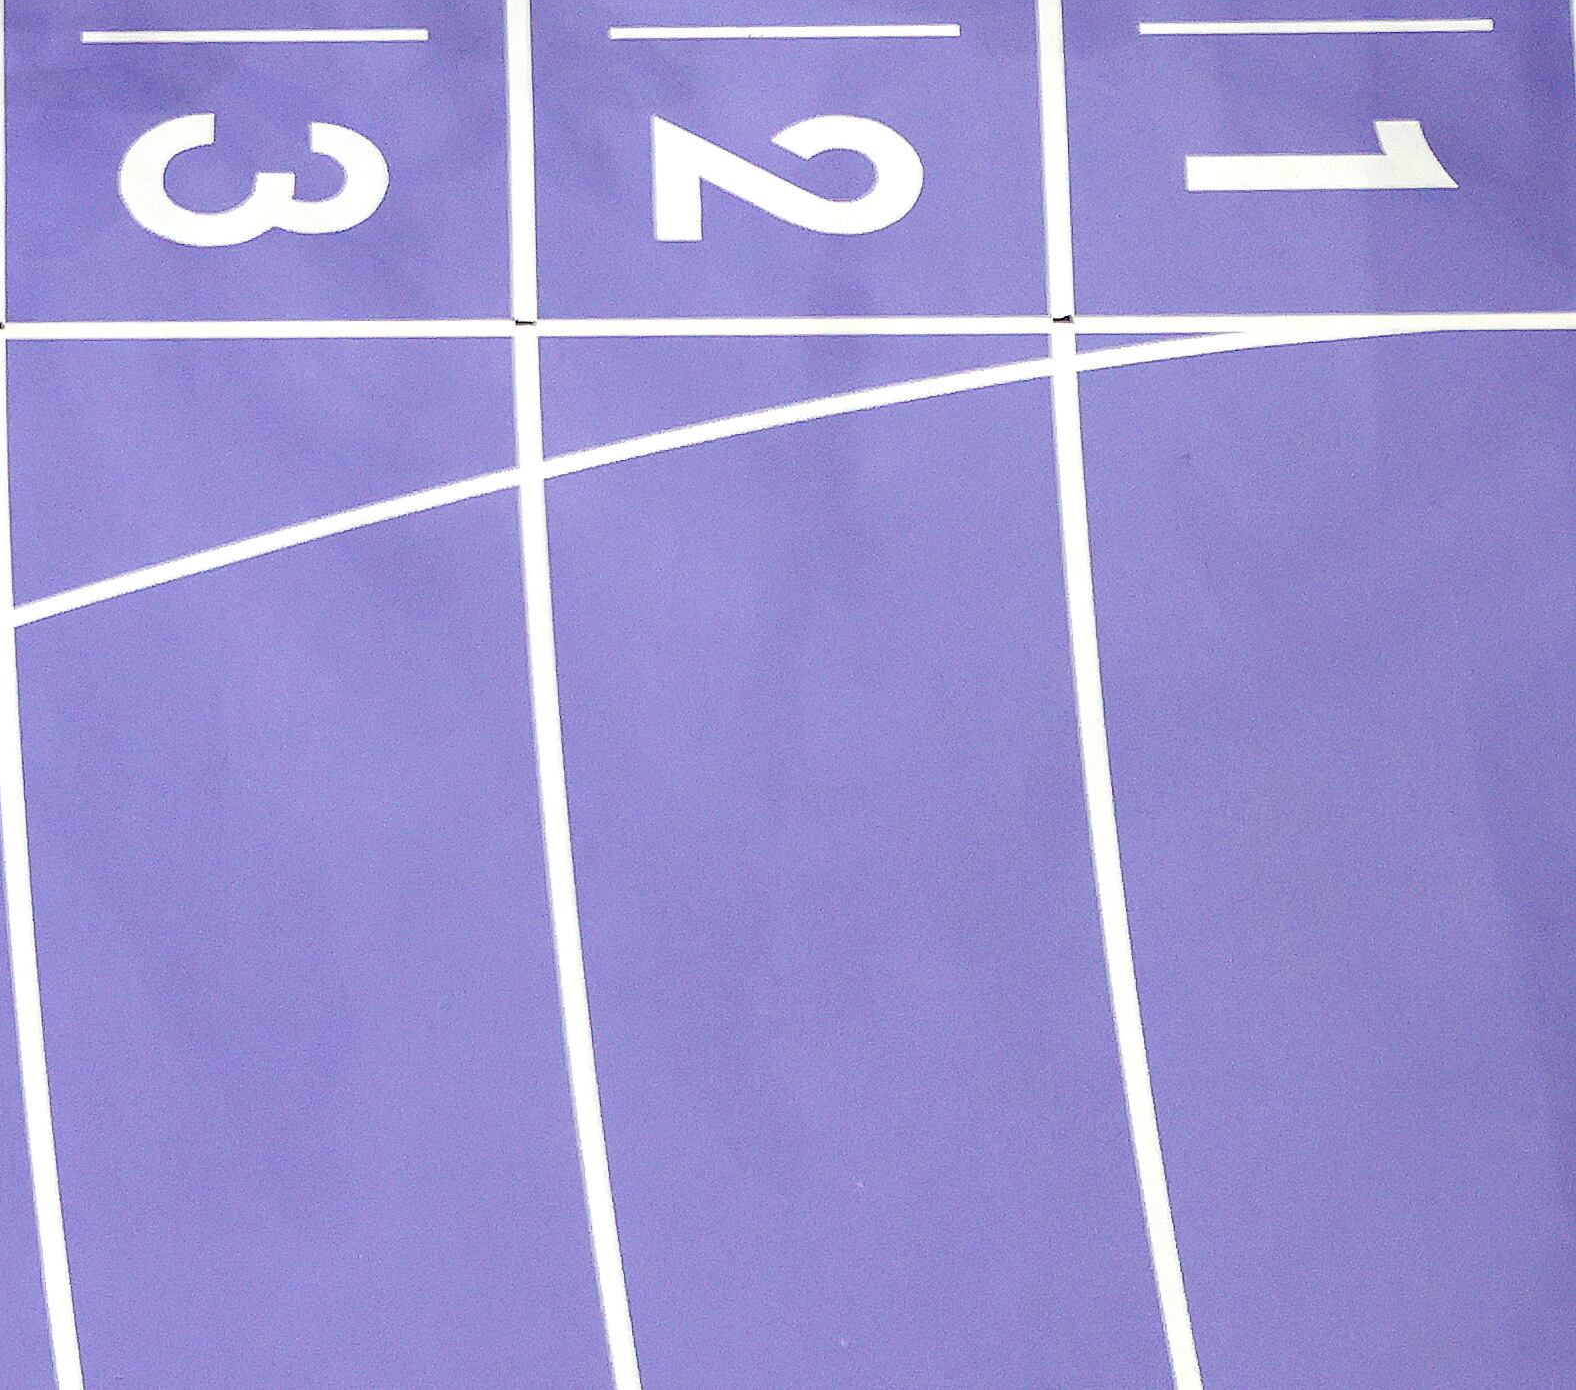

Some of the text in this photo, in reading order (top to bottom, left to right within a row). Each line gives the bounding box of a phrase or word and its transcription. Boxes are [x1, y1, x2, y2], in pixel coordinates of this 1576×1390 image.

[118, 114, 389, 246] 3
[651, 115, 923, 241] 2
[1185, 121, 1458, 191] 1
